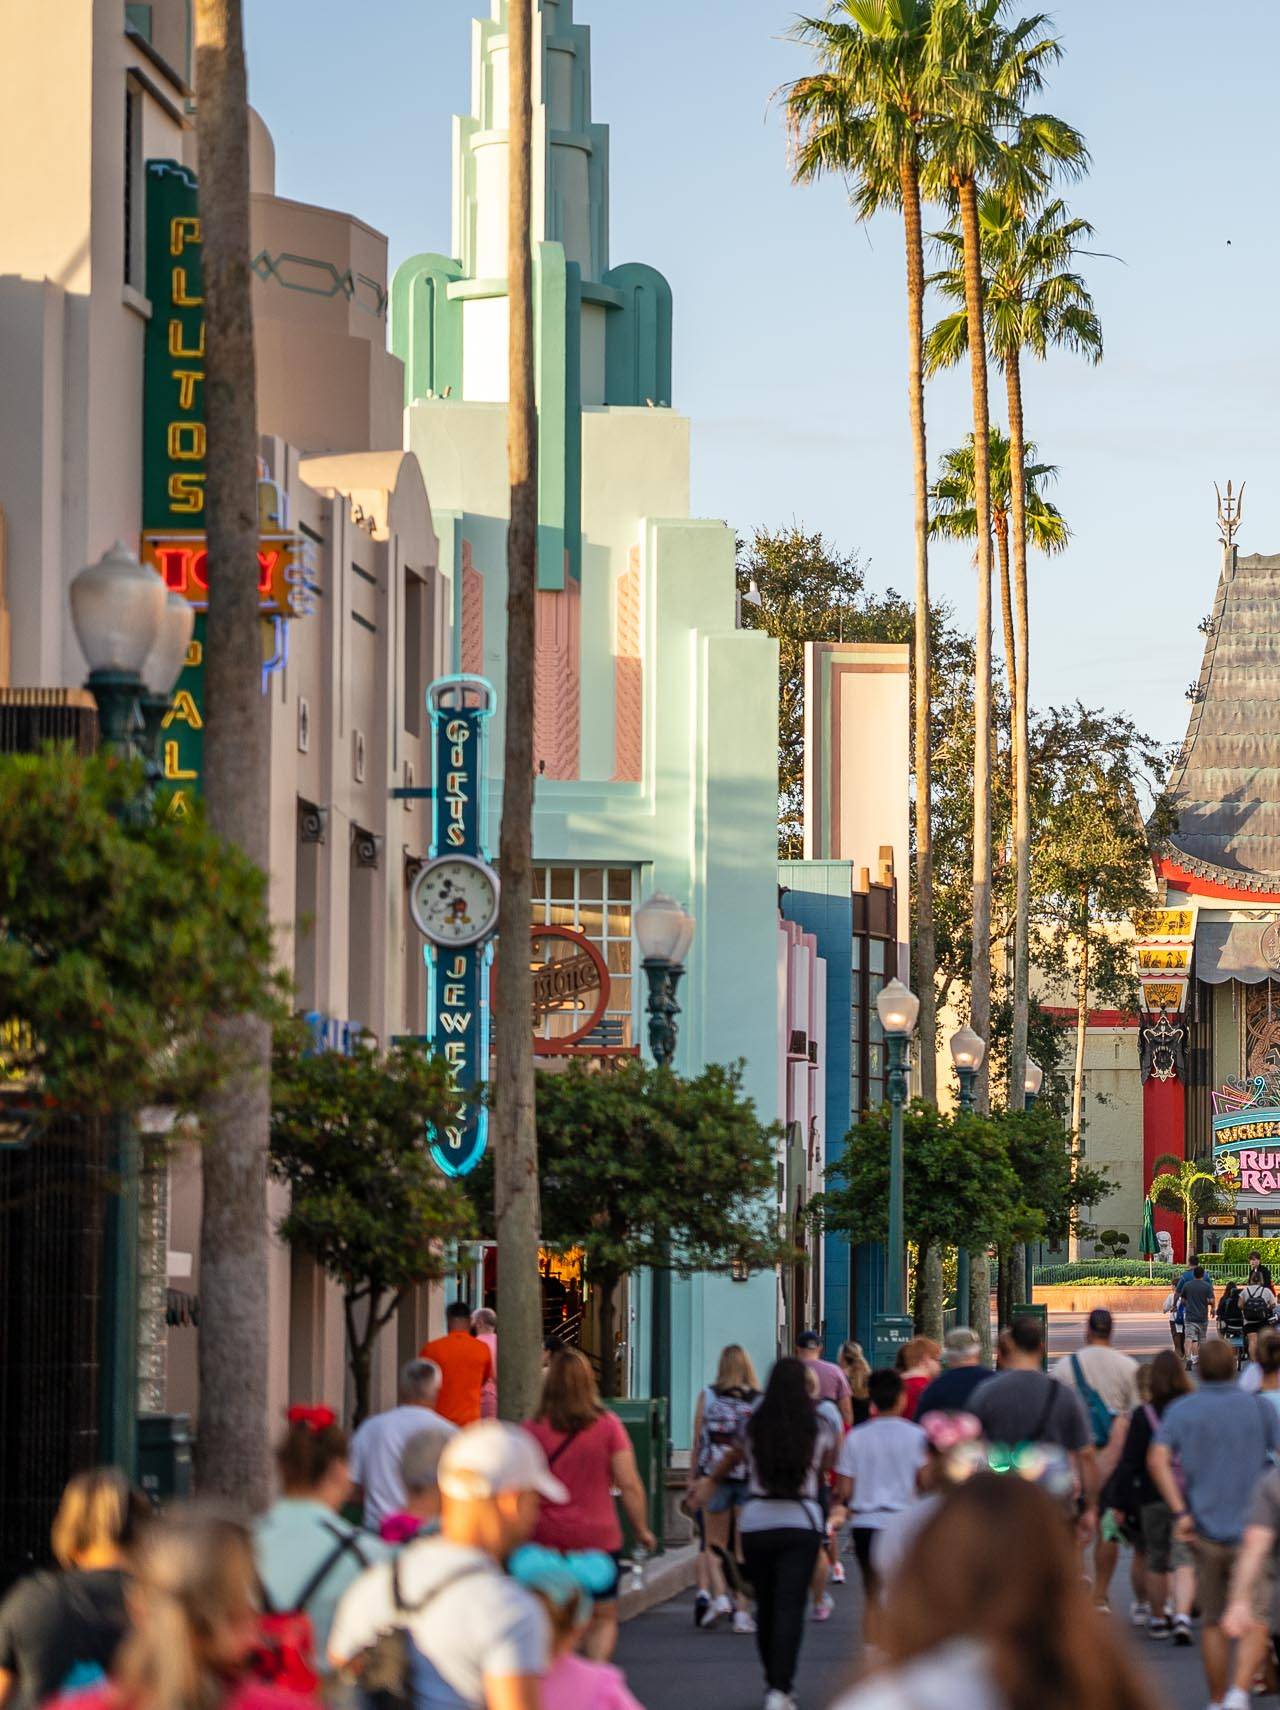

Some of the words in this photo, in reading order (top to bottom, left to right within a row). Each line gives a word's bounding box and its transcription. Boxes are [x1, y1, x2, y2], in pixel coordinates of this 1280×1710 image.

[169, 216, 206, 513] PLUTOS
[445, 719, 470, 846] GIFTS
[1215, 1121, 1275, 1144] MICKEY
